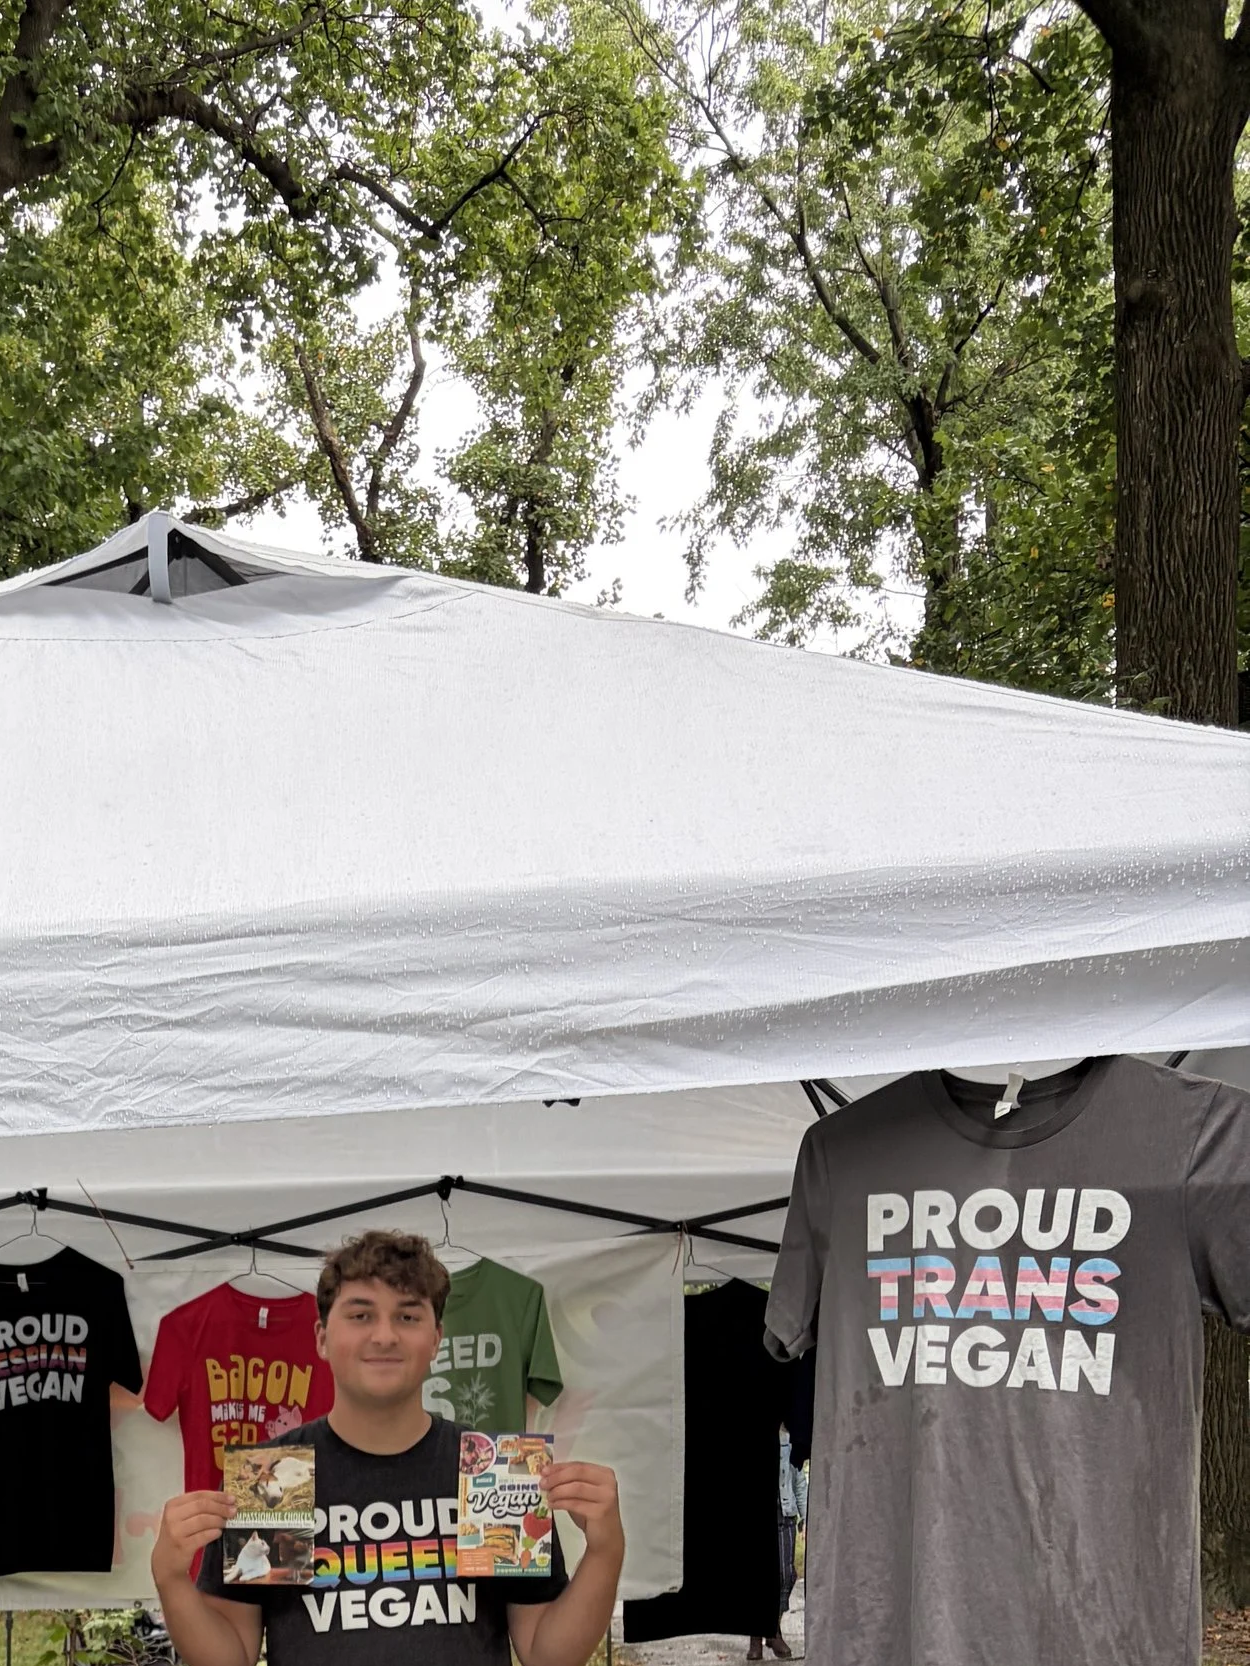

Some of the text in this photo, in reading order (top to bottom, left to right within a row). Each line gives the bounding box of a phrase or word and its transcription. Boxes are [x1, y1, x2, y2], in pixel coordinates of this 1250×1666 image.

[866, 1188, 1132, 1253] PROUD
[866, 1255, 1121, 1326] TRANS
[867, 1325, 1116, 1396] VEGAN
[248, 1404, 266, 1423] ME
[467, 1488, 541, 1519] Vegan
[302, 1583, 477, 1633] VEGAN
